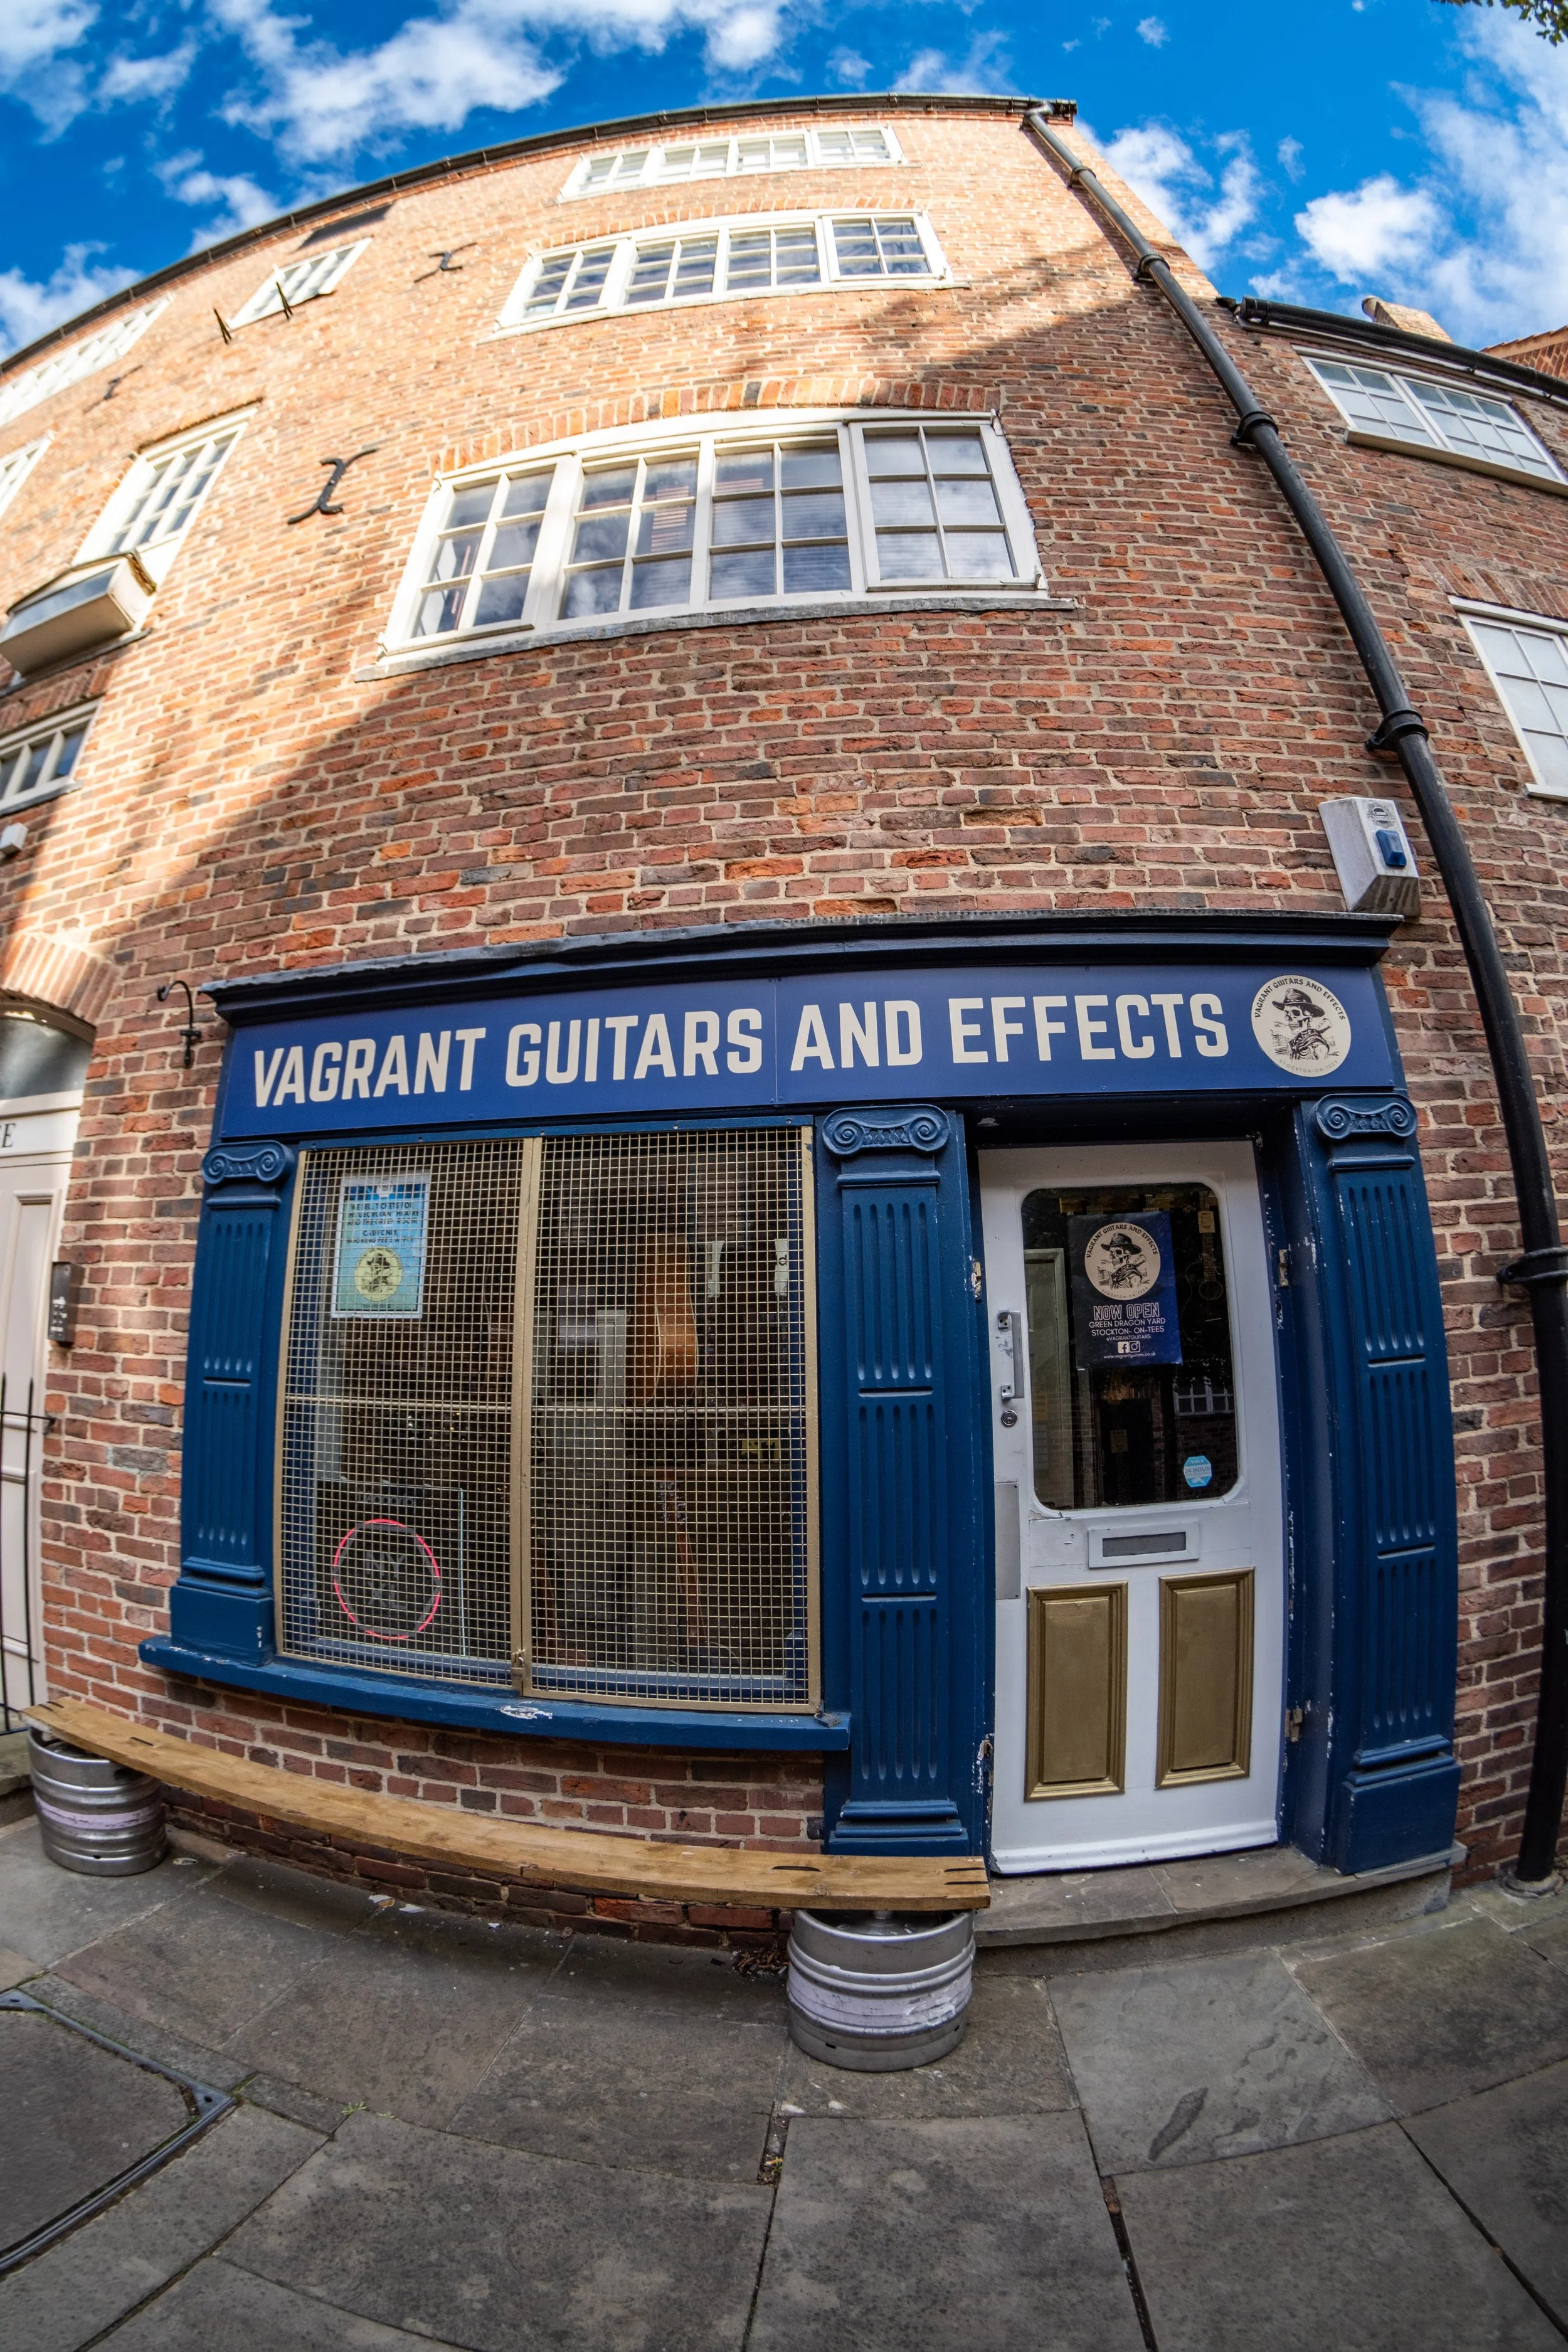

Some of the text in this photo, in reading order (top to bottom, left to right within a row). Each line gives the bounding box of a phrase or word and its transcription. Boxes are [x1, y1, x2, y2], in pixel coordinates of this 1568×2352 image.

[1254, 978, 1347, 1020] VAGRANT GUITARS AND EFFECTS
[253, 993, 1230, 1108] VAGRANT GUITARS AND EFFECTS
[1278, 1059, 1339, 1074] STOCKTON-ON-TEES
[376, 1202, 400, 1210] TCETS
[1086, 1224, 1159, 1258] VAGRANT GUITARS AND EFFECTS
[1093, 1302, 1160, 1321] NOW OPEN
[1089, 1319, 1113, 1328] GREEN
[1114, 1318, 1146, 1328] DRAGON
[1091, 1325, 1165, 1337] STOCKTON- ON-TEES
[1103, 1351, 1156, 1360] www.vagrantguitars.co.uk
